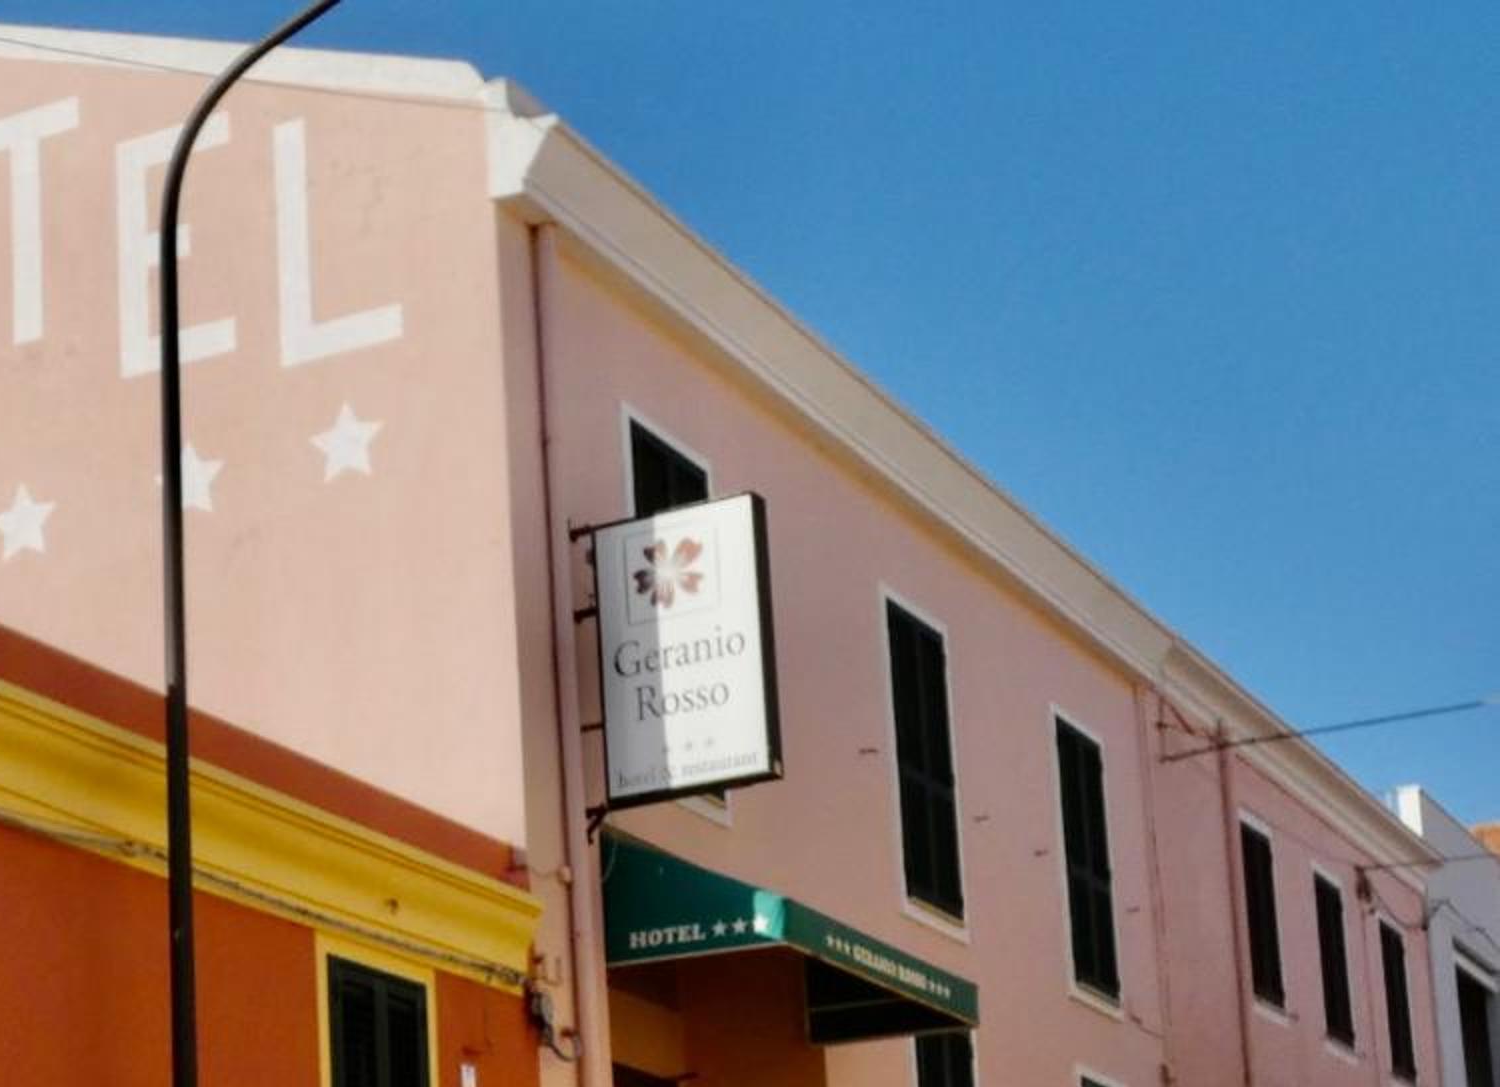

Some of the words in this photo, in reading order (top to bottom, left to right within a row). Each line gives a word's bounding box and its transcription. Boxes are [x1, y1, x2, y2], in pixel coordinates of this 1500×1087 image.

[614, 625, 746, 678] Geranio
[636, 682, 730, 721] Rosso
[628, 923, 707, 949] HOTEL
